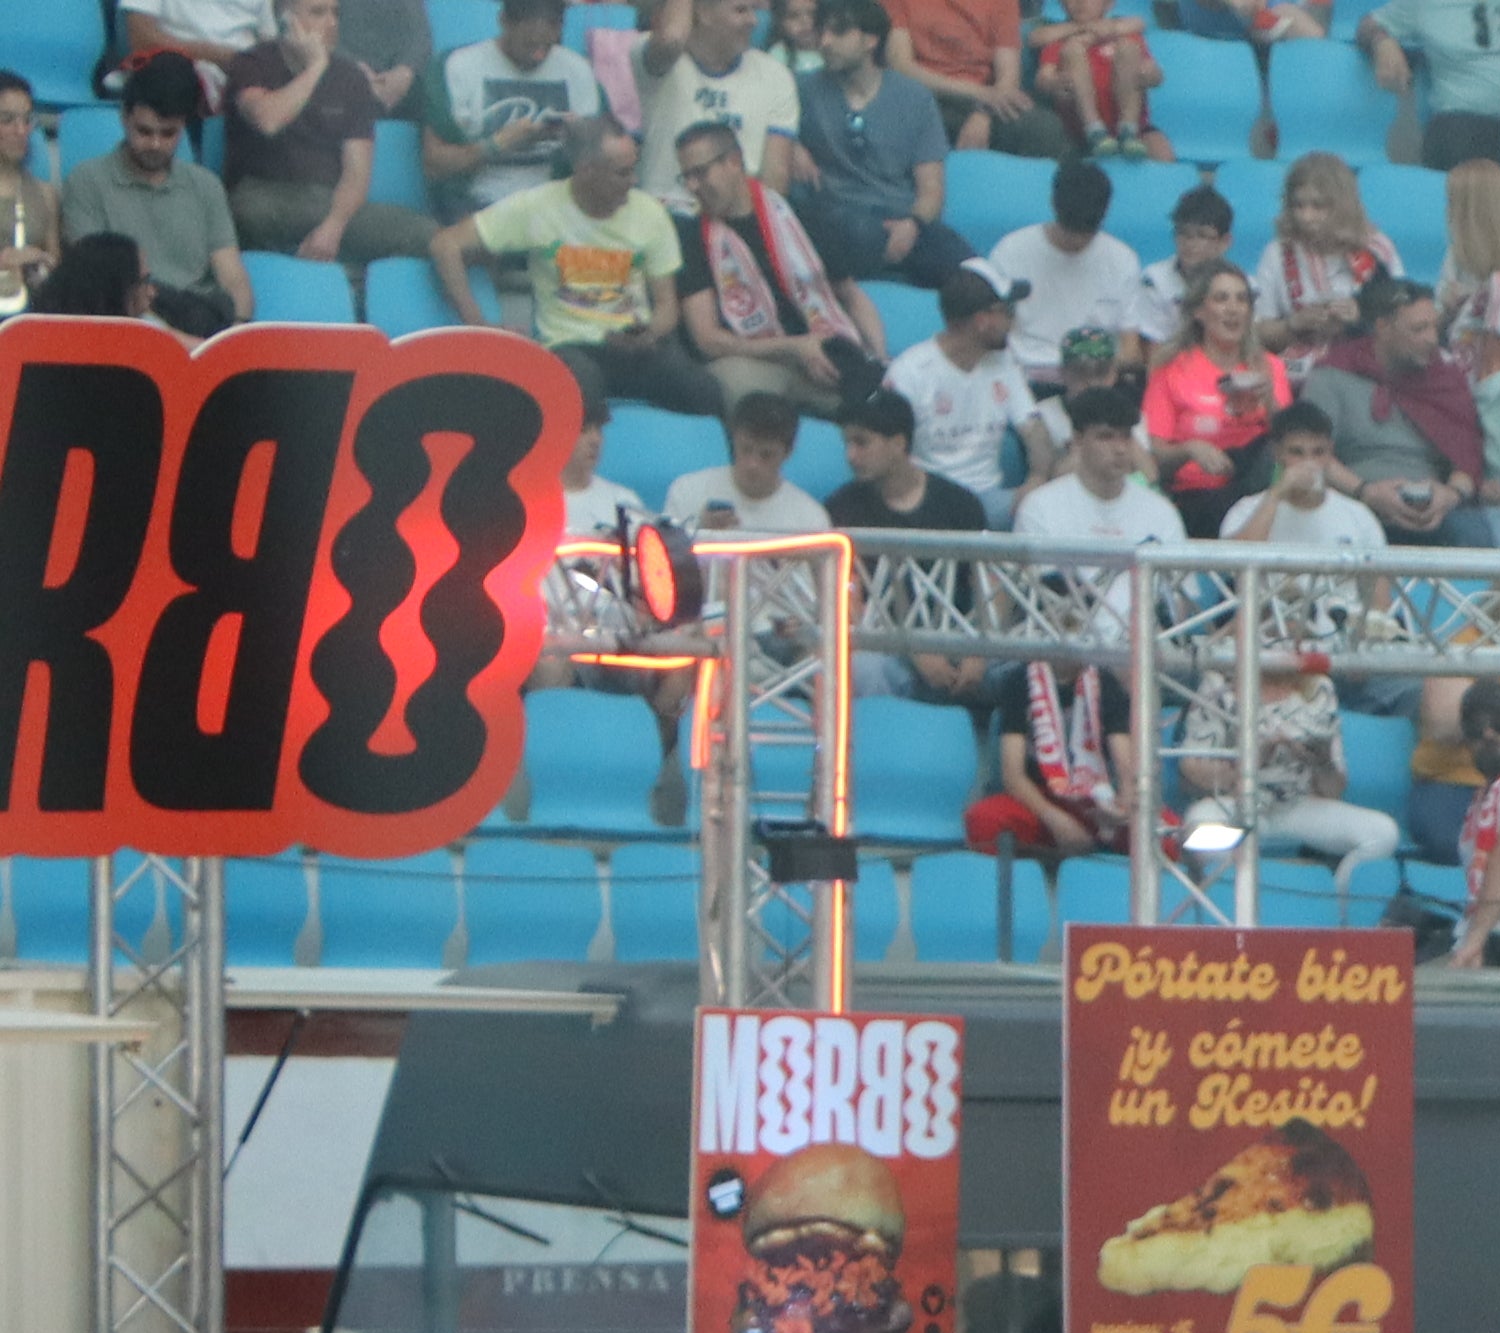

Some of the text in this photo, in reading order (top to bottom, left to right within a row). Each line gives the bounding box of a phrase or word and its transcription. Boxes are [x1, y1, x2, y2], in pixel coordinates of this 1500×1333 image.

[1074, 942, 1408, 1005] Pórtate bien
[1118, 1018, 1365, 1085] ¡y cómete
[702, 1014, 961, 1159] MORBO
[1107, 1073, 1379, 1131] un Kesito!
